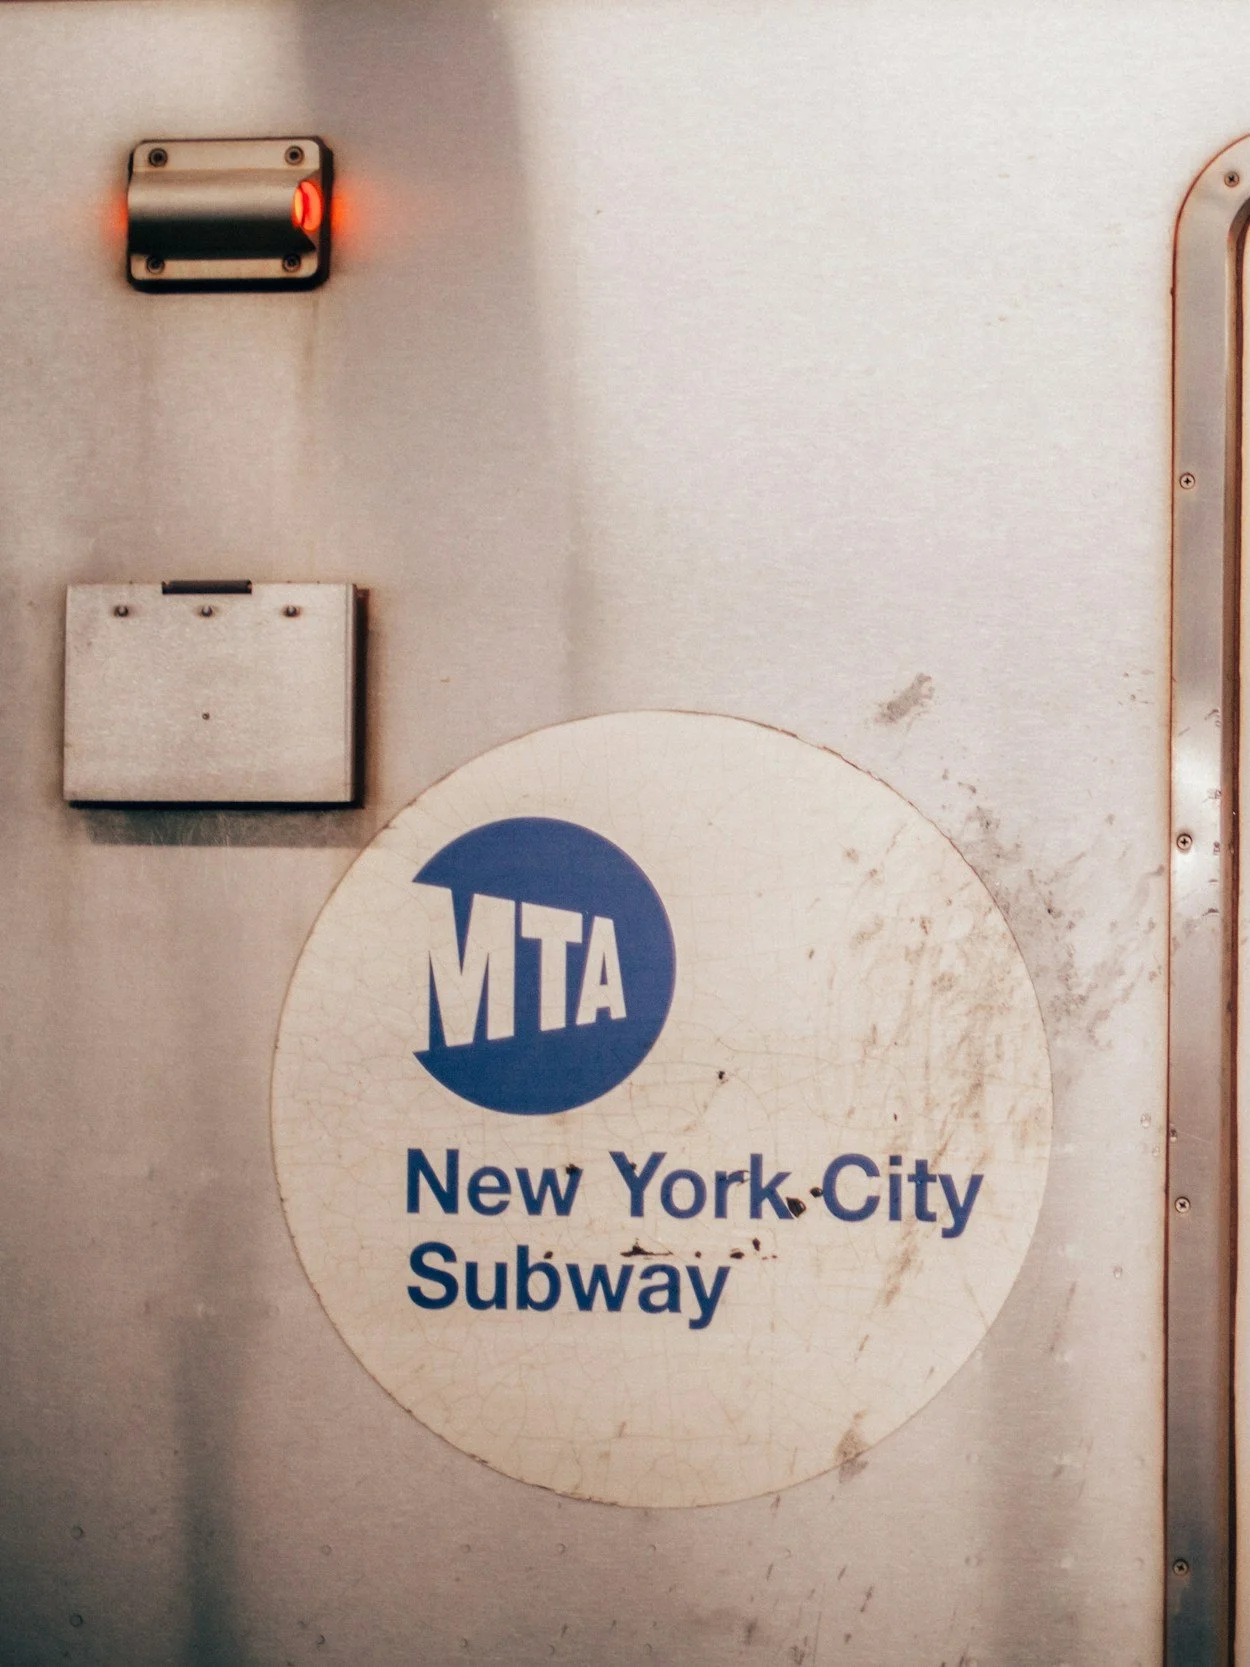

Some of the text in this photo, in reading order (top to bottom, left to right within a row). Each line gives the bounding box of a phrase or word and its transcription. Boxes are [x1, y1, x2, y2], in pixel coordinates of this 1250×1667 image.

[413, 882, 627, 1051] MTA
[406, 1147, 984, 1239] New York City
[406, 1241, 731, 1330] Subway
